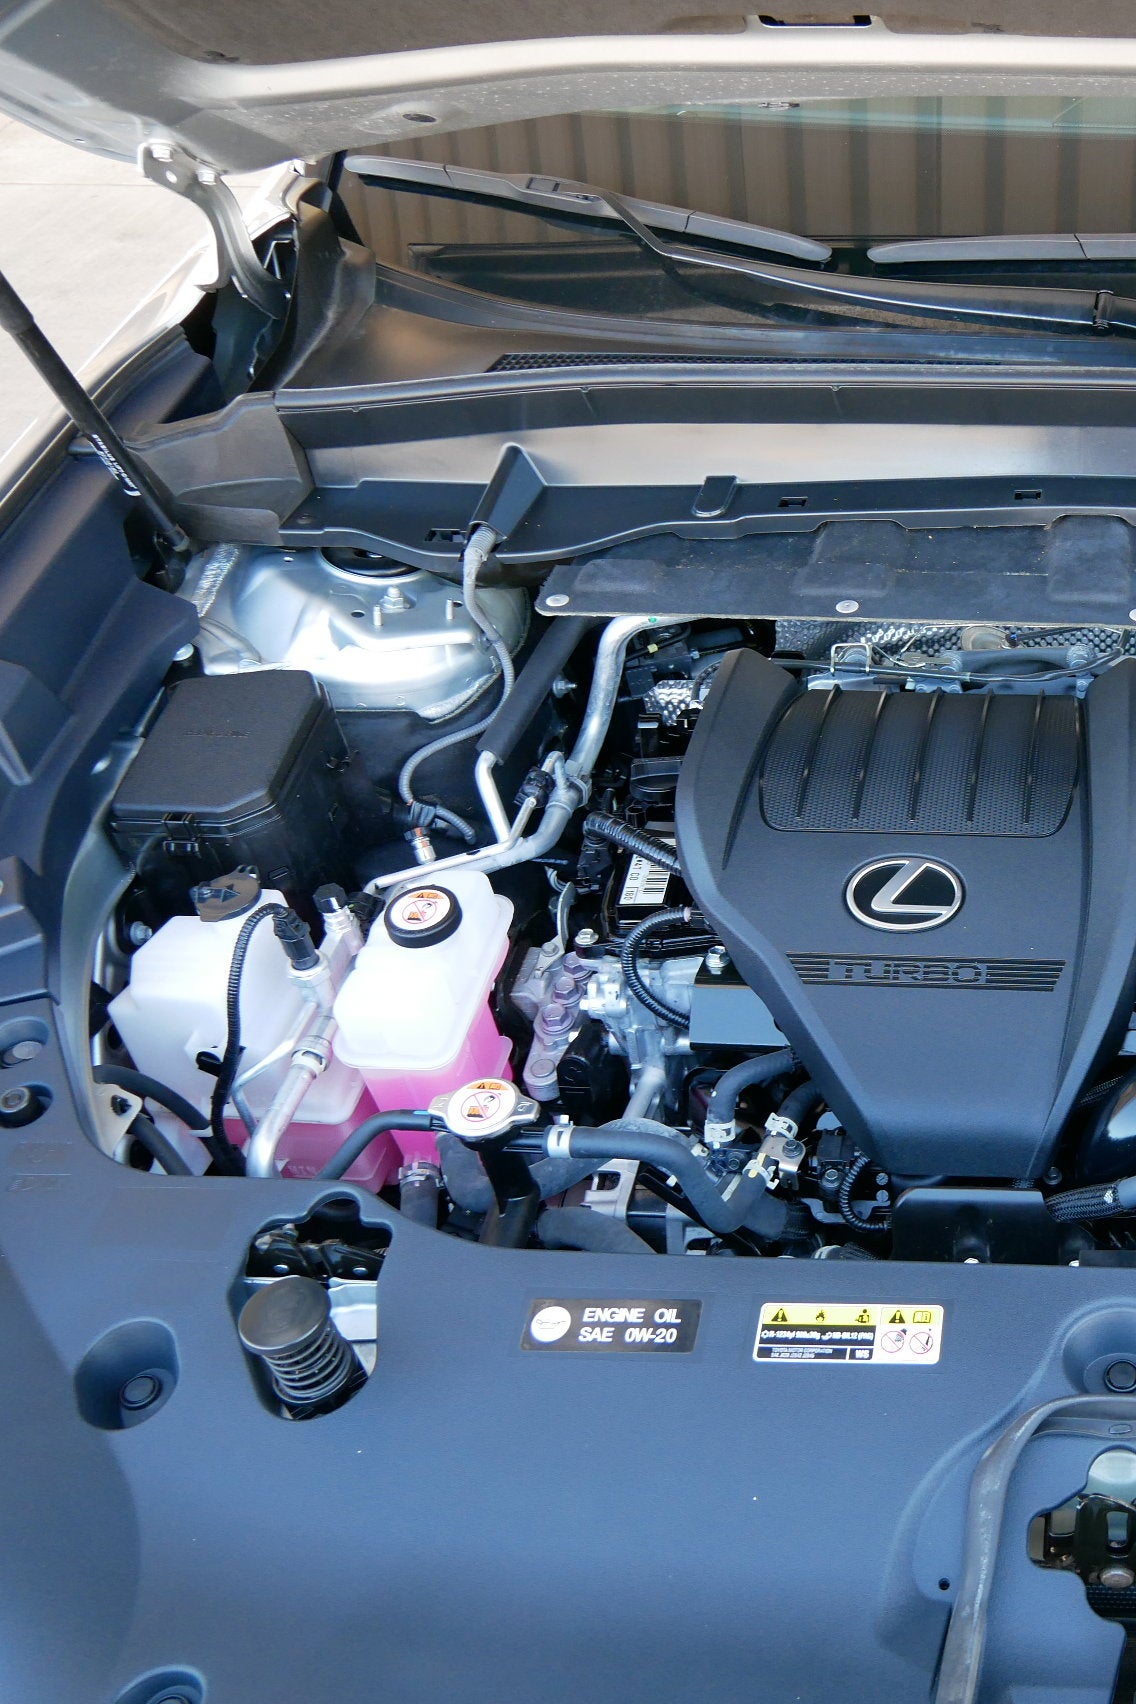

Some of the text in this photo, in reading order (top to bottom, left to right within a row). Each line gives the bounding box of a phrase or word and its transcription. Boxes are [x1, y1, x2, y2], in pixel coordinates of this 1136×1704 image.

[832, 960, 983, 984] TURBO
[582, 1307, 682, 1324] ENGINE OIL
[578, 1327, 678, 1344] SAE 0W-20
